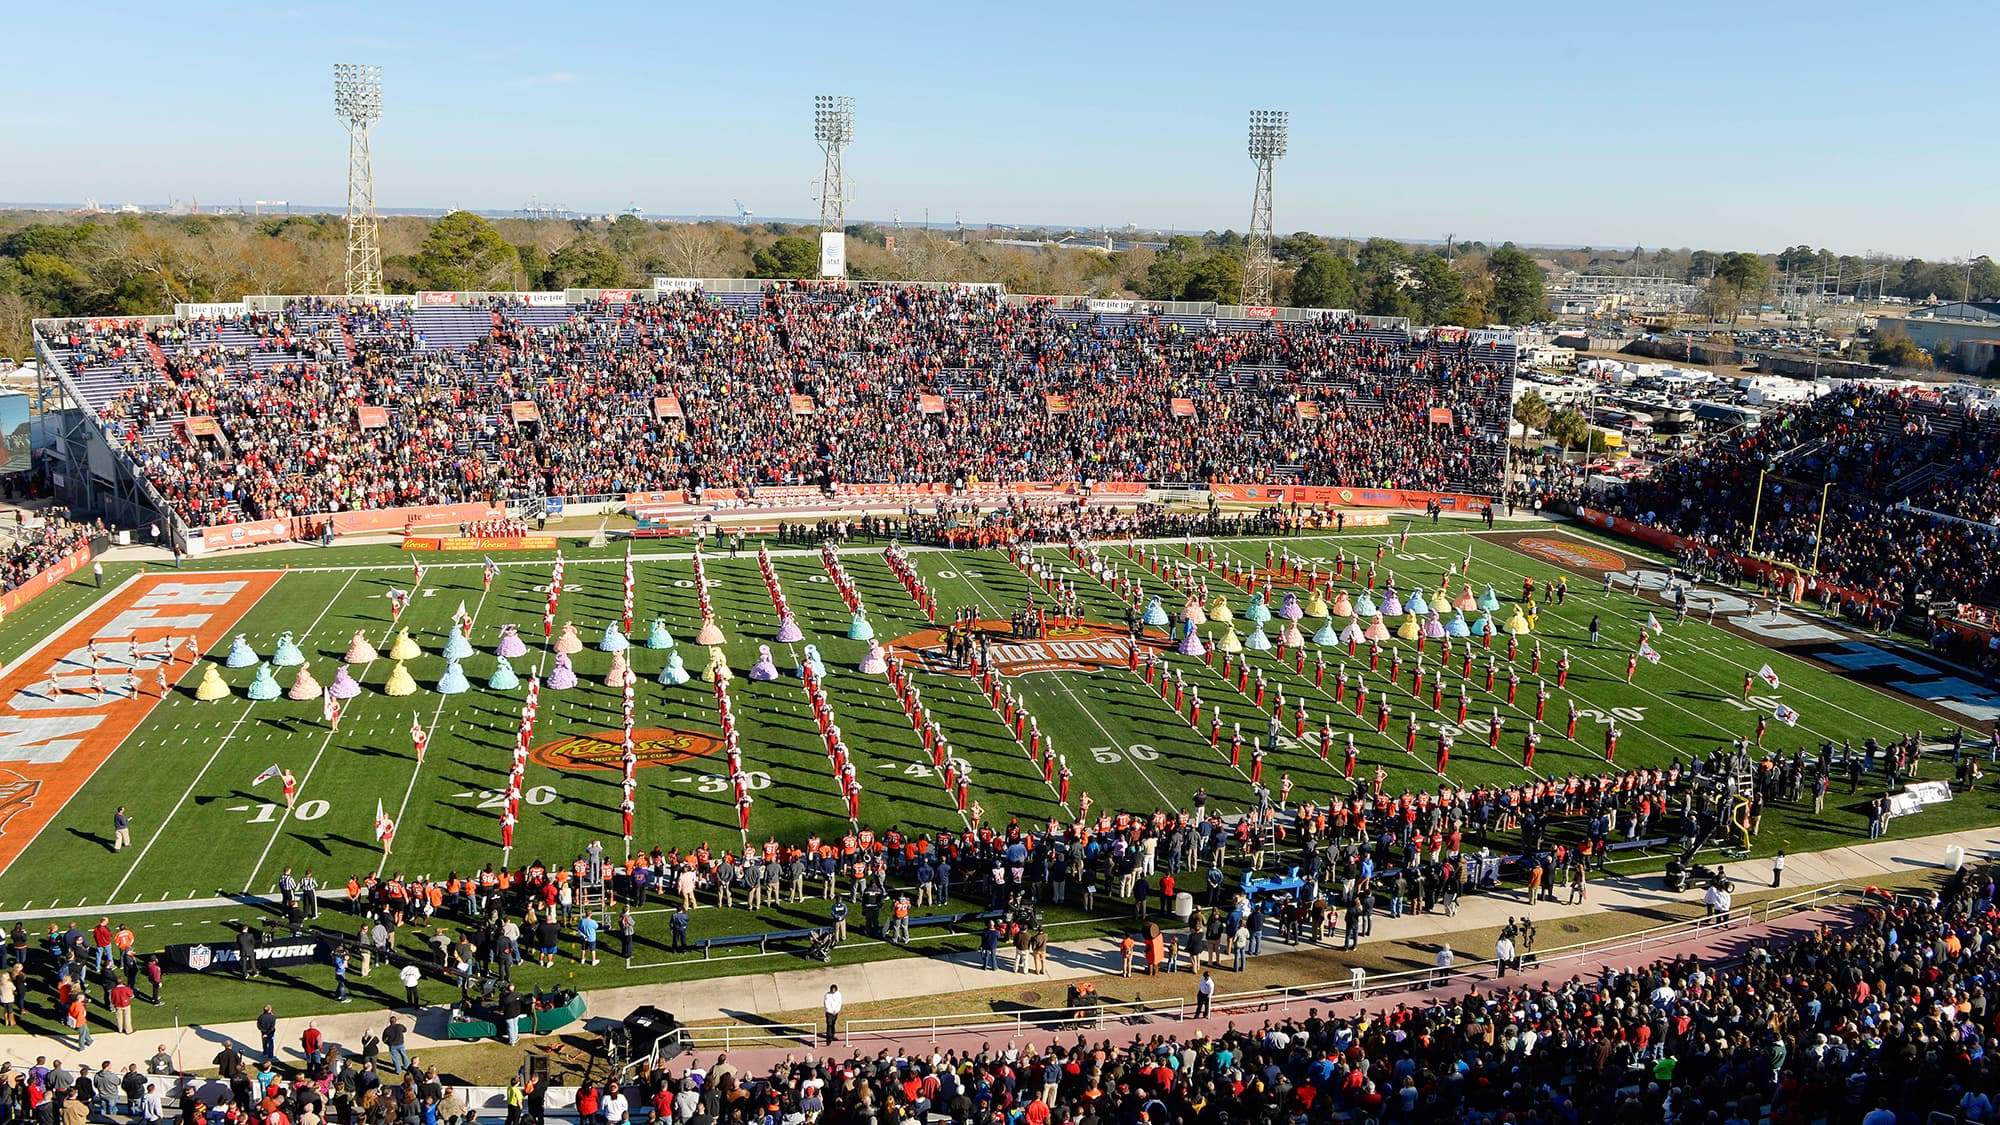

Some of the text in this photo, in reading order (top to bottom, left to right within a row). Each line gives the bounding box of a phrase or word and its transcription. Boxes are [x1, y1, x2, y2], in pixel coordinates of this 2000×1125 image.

[1089, 743, 1160, 764] 50
[246, 800, 331, 824] 10
[192, 944, 317, 966] NFL NEWORK
